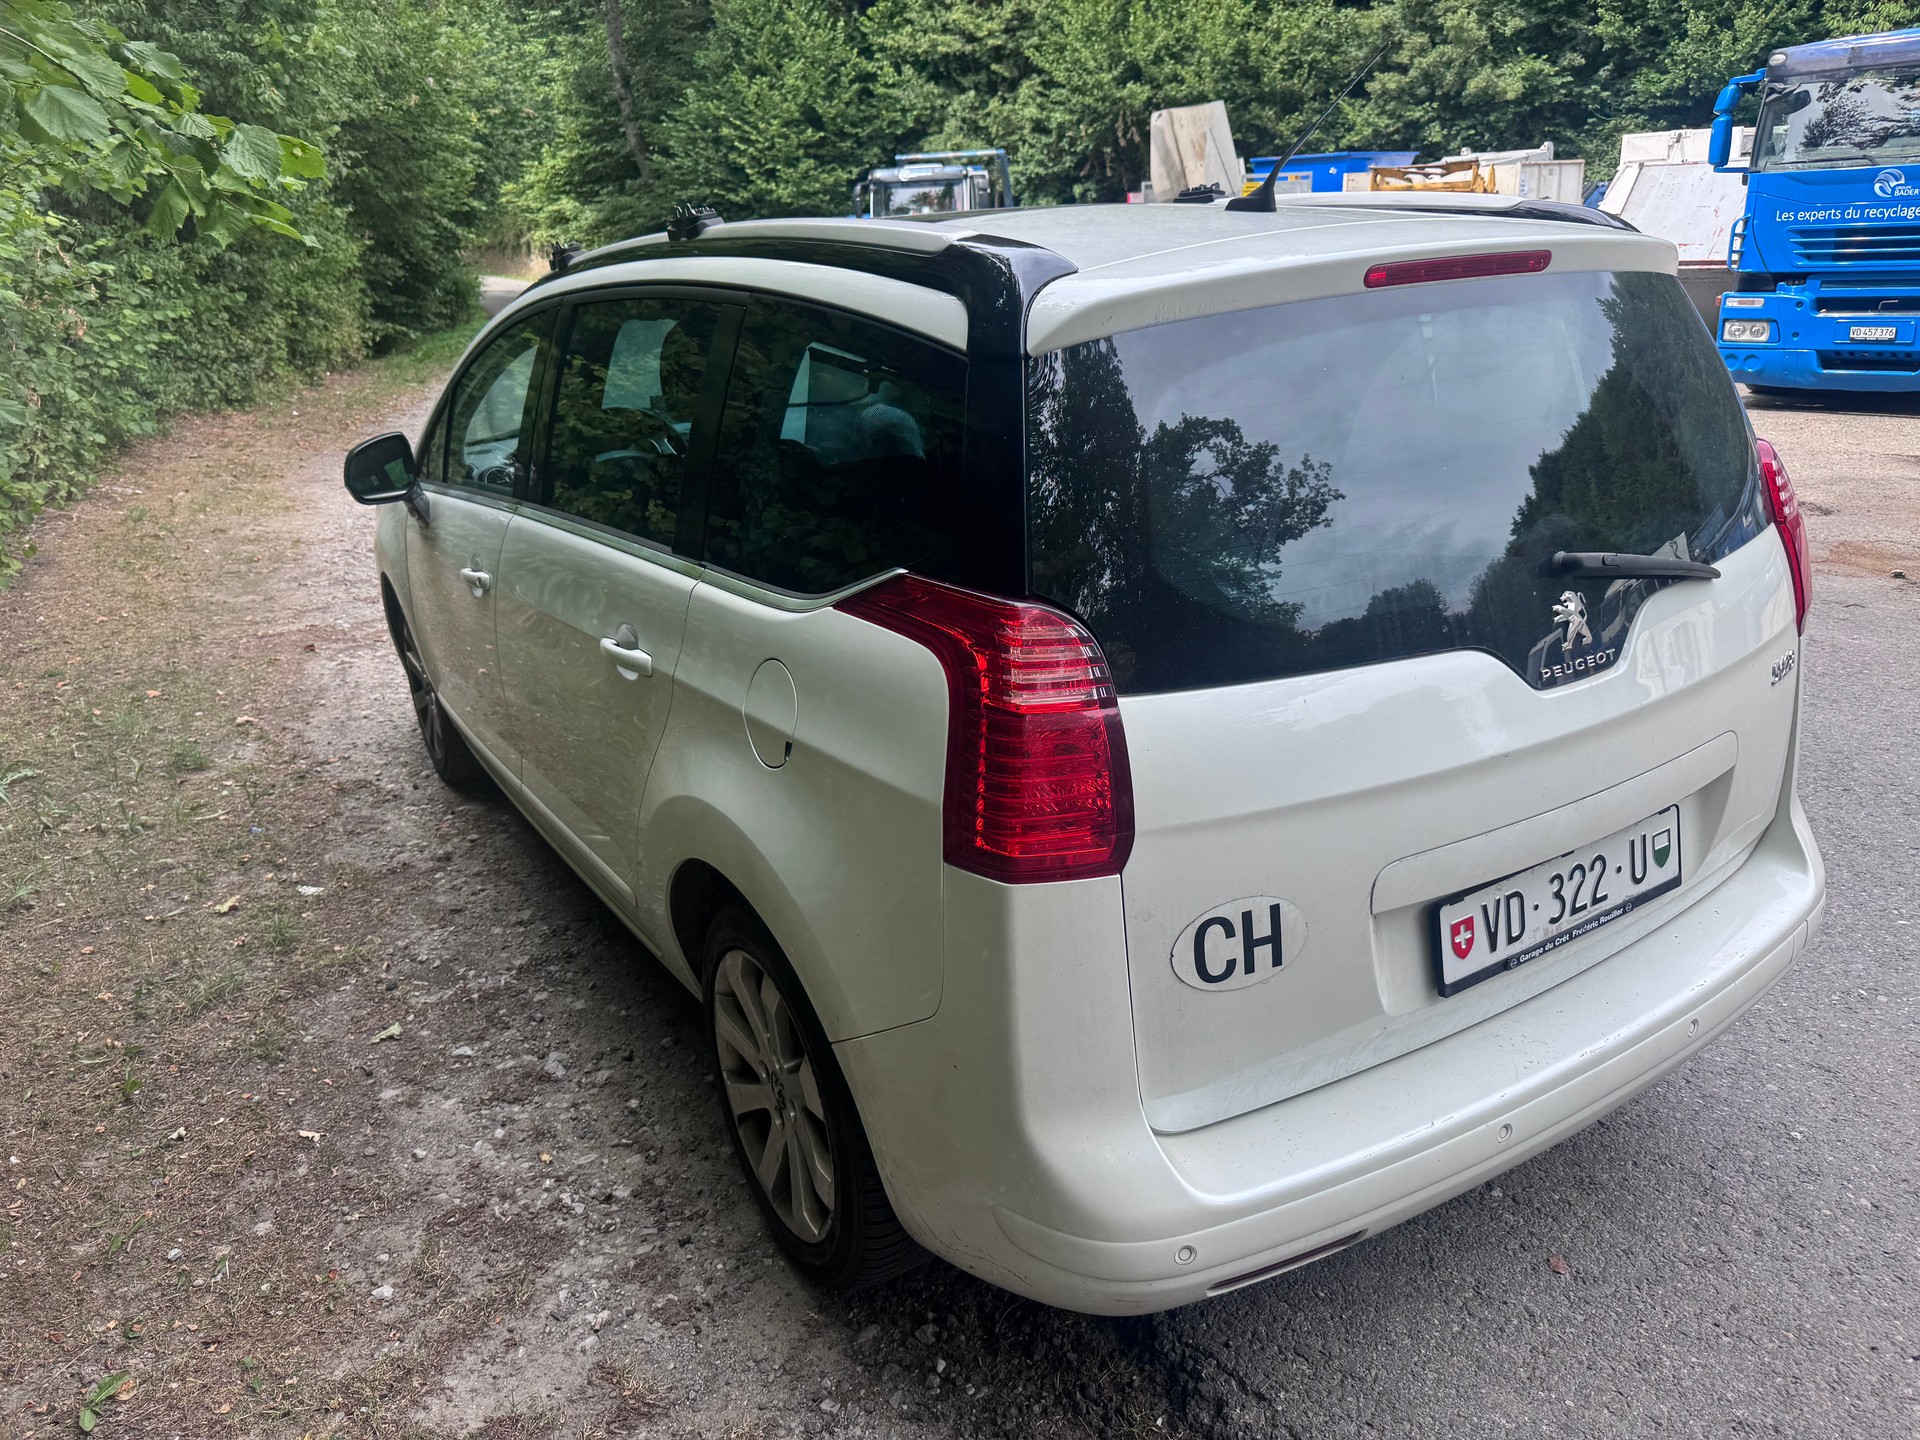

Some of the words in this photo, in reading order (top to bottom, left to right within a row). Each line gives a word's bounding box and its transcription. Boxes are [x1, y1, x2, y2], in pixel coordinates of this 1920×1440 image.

[1776, 210, 1794, 221] Les
[1797, 208, 1841, 222] experts
[1844, 206, 1860, 219] du
[1864, 204, 1920, 219] recyclage
[1541, 648, 1616, 681] PEUGEOT
[1193, 903, 1283, 983] CH
[1520, 947, 1544, 963] Garage
[1545, 942, 1554, 951] du
[1555, 933, 1570, 946] Crêt
[1600, 907, 1624, 925] Rouiller
